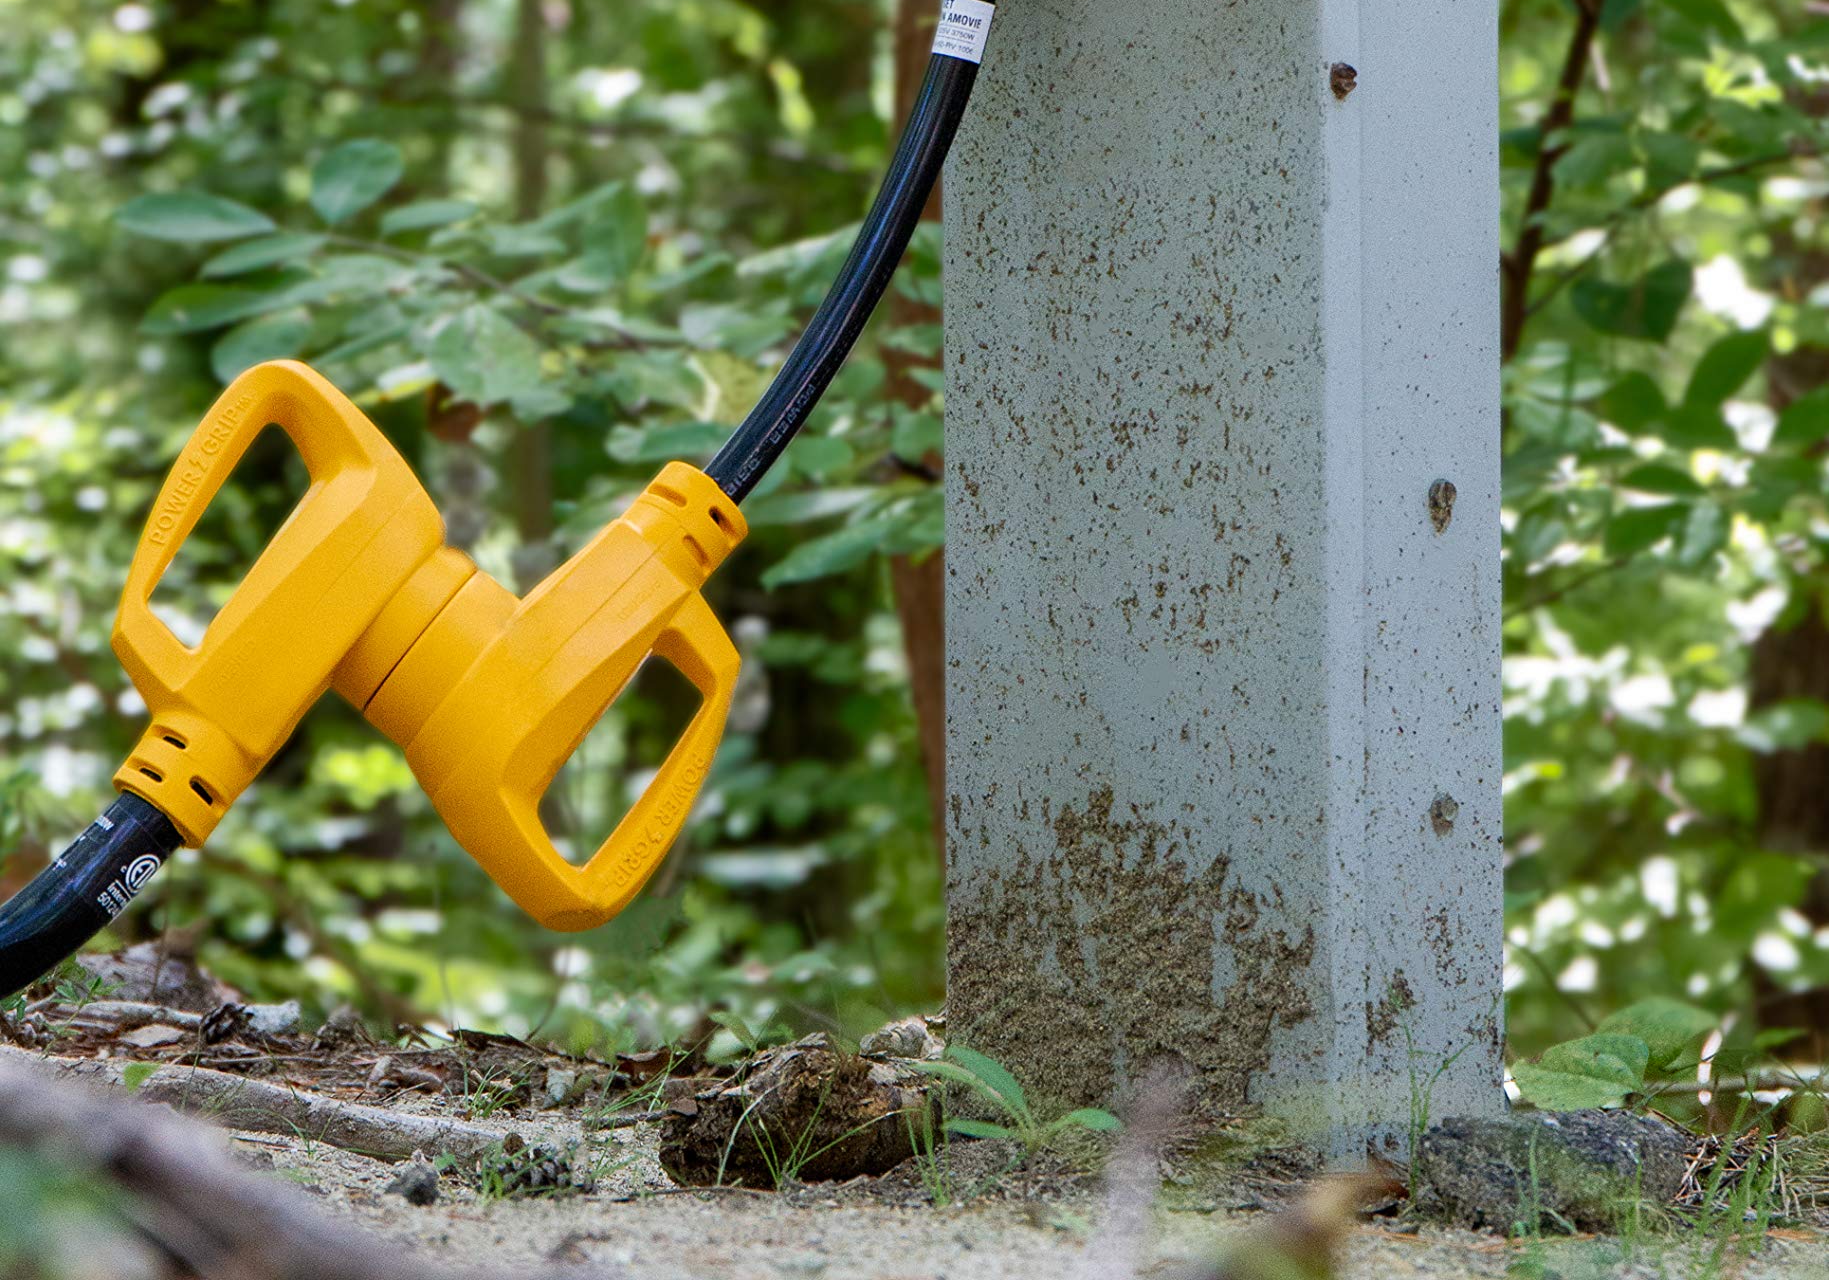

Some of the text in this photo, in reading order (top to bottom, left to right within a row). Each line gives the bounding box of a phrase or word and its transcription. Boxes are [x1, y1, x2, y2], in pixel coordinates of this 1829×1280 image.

[151, 471, 201, 546] POWER
[201, 407, 239, 457] GRIP
[614, 753, 706, 888] POWER GRIP
